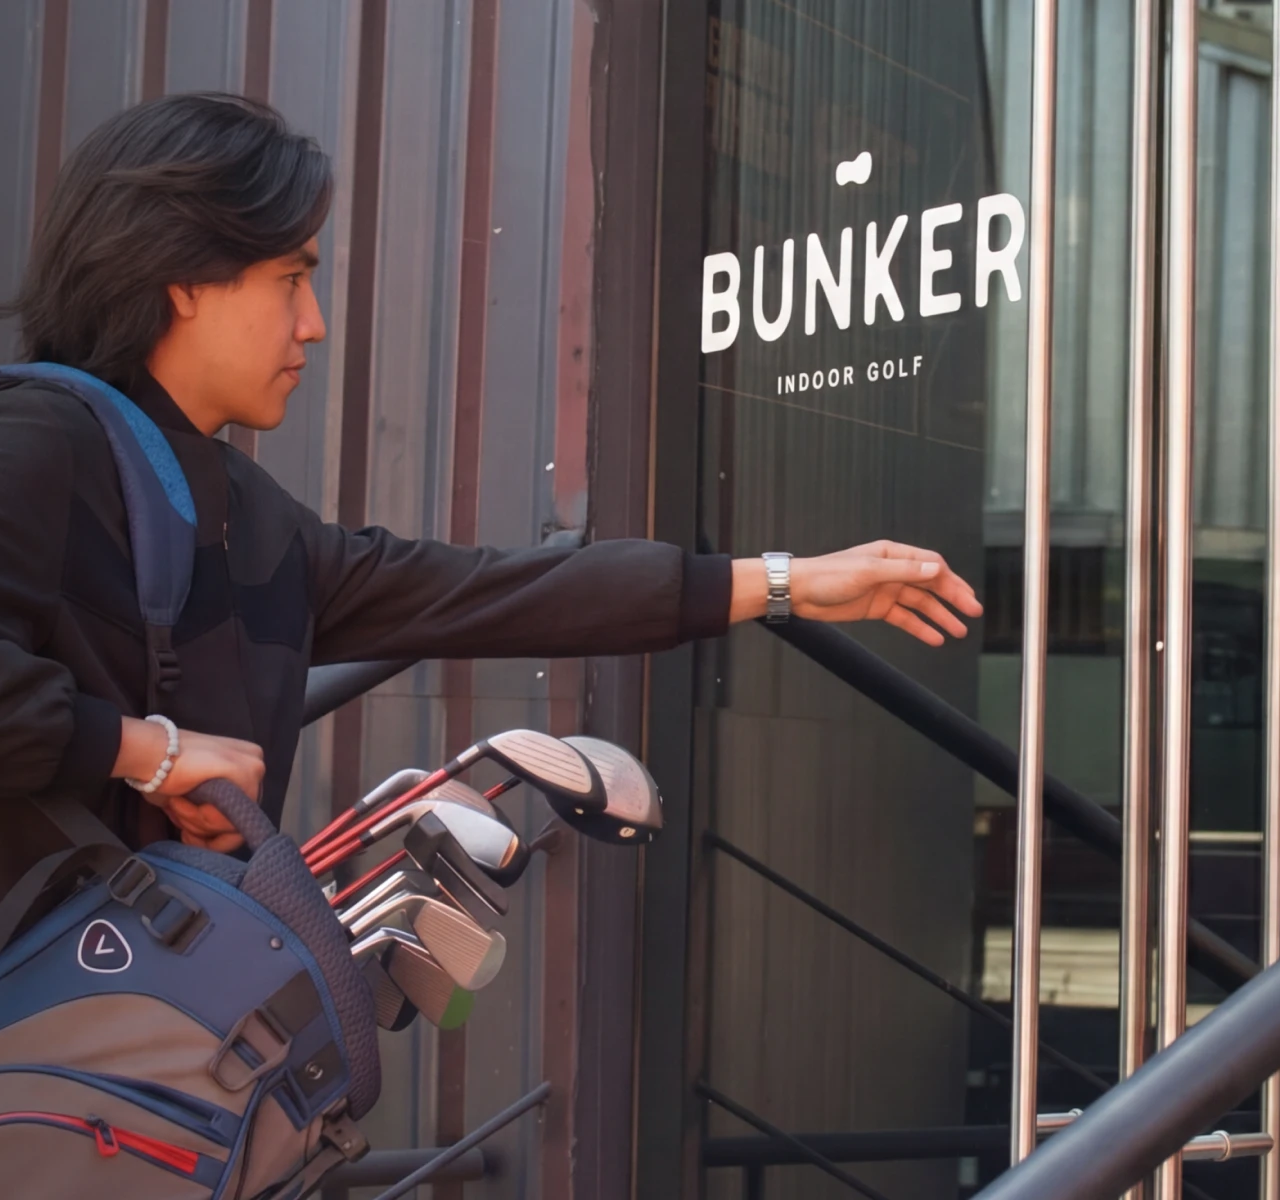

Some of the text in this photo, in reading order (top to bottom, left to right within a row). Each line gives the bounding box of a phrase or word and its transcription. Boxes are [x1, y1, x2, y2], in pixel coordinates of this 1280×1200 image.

[700, 192, 1026, 354] BUNKER
[776, 355, 924, 395] INDOOR GOLF
